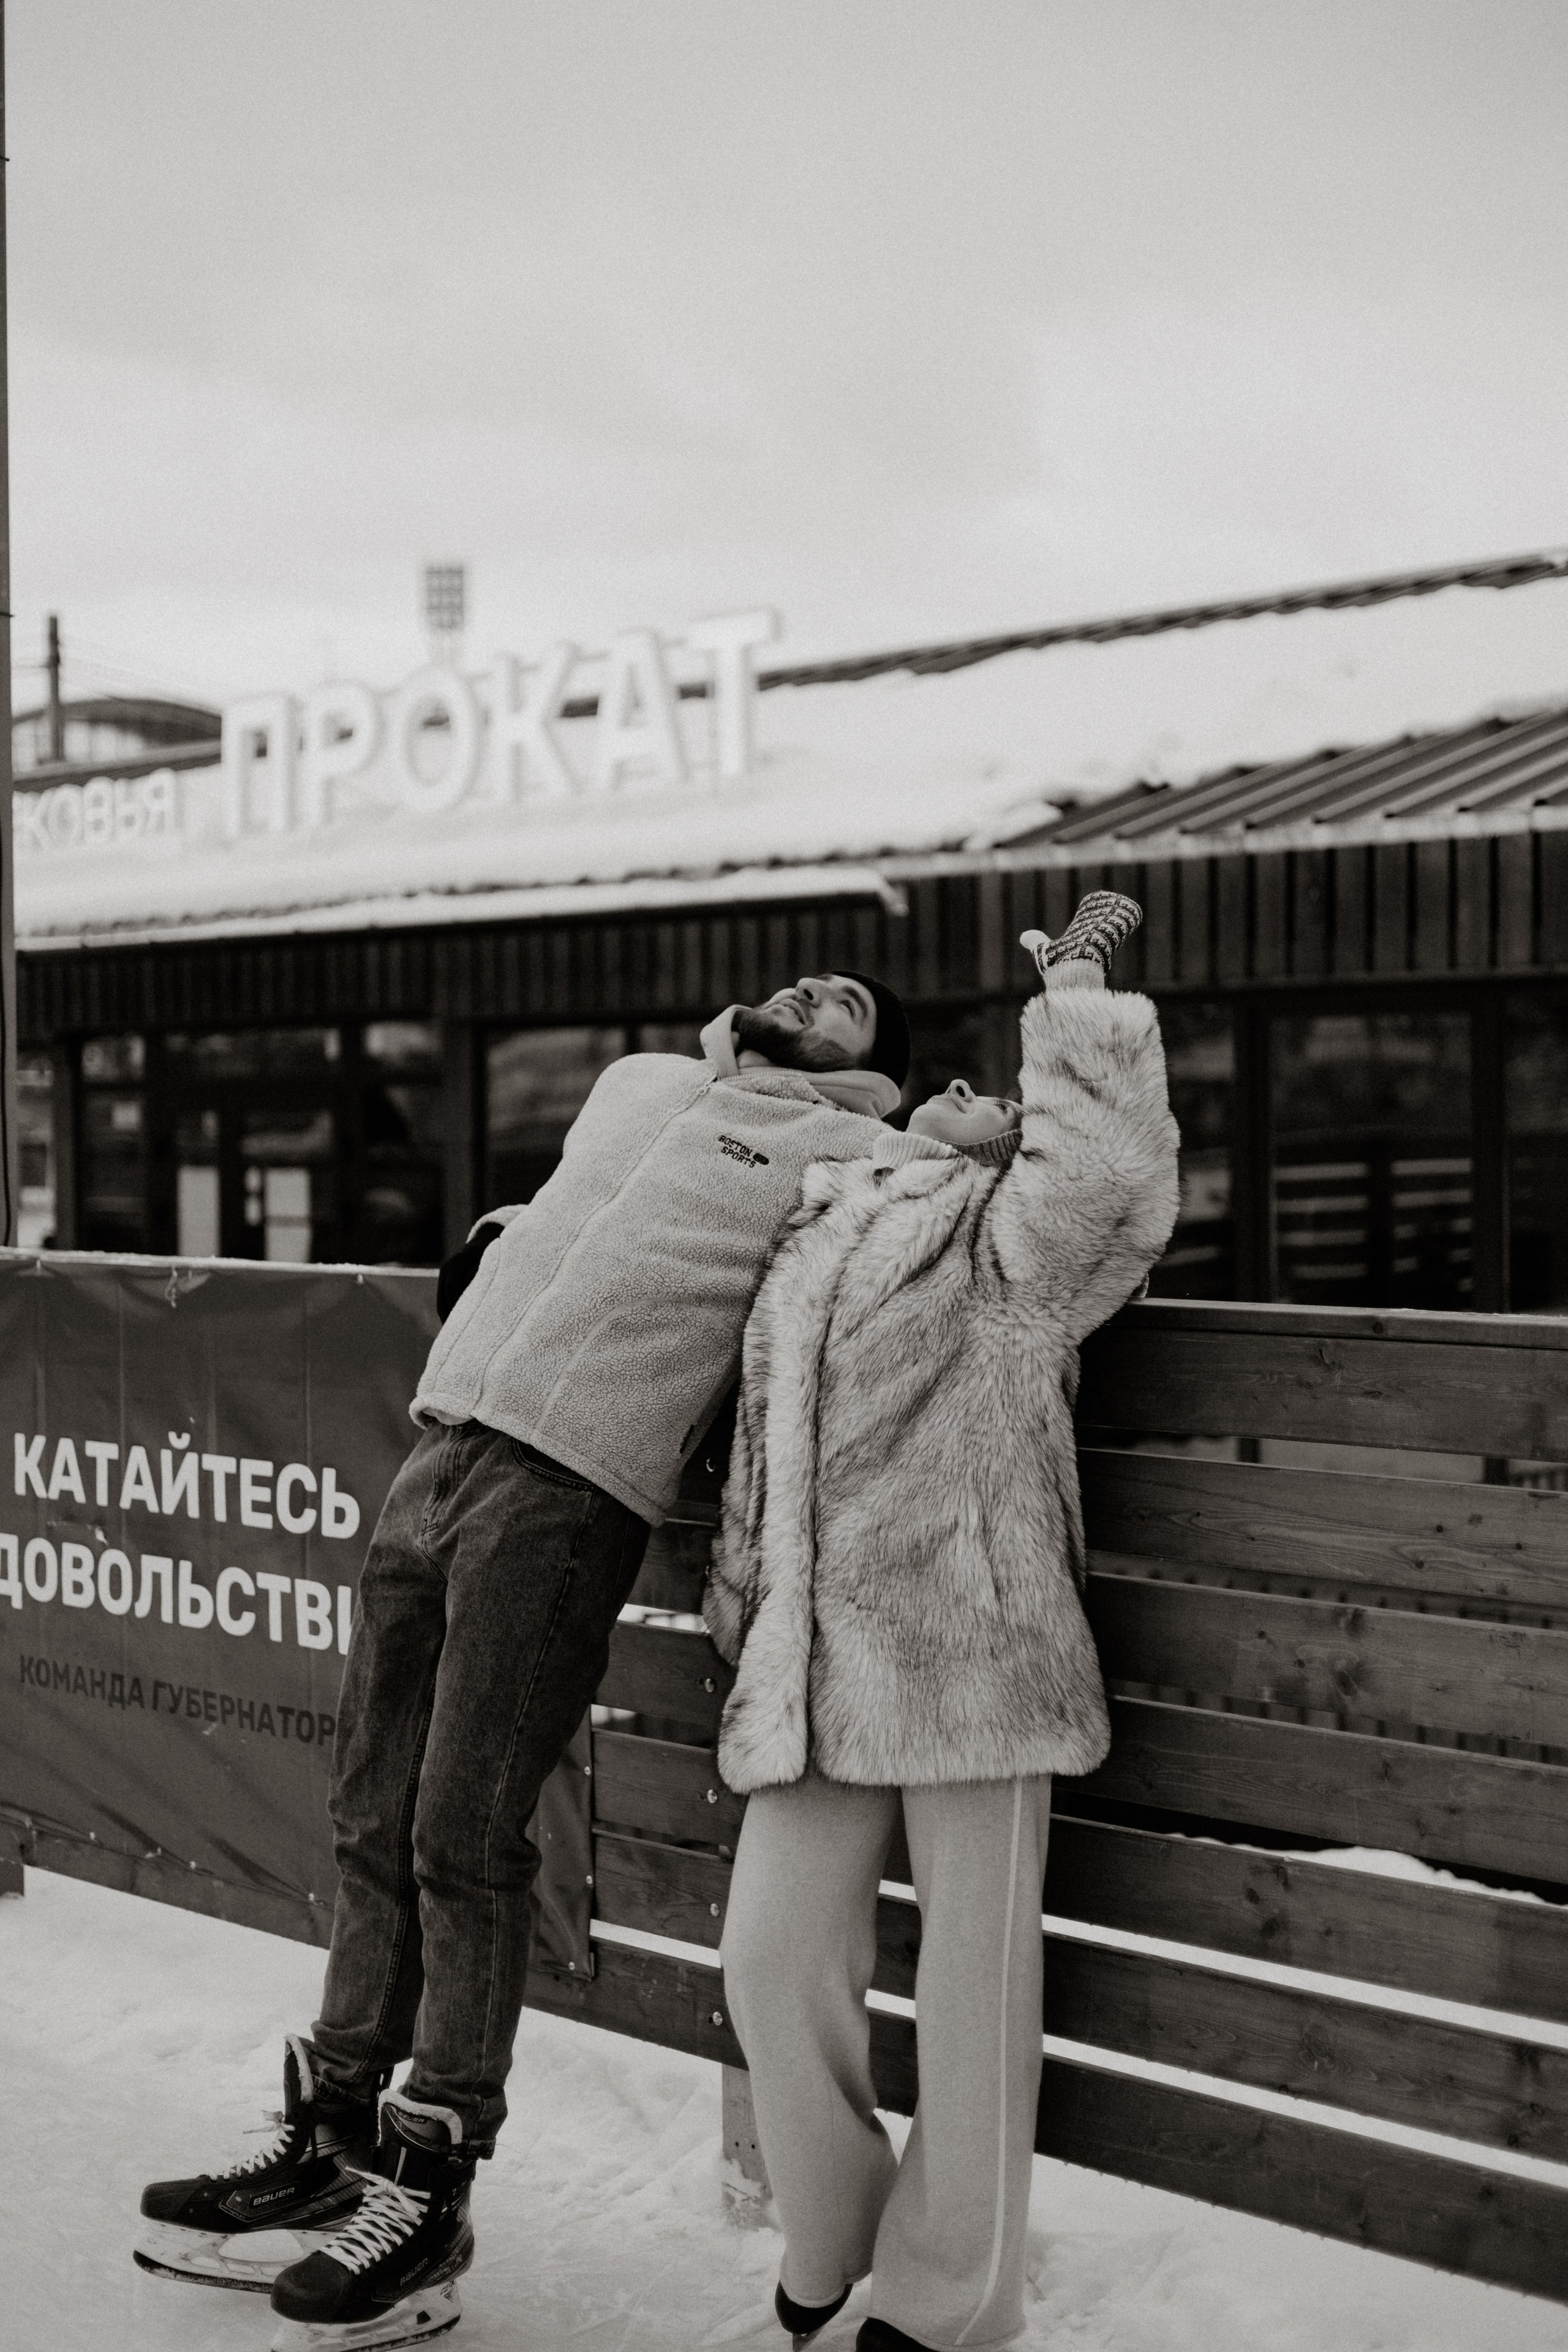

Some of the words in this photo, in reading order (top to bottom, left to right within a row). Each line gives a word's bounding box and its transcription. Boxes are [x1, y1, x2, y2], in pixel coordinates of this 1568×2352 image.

[221, 608, 778, 837] ПРОКАТ
[13, 767, 174, 850] КОВЬЯ
[718, 1135, 753, 1157] BOSTON
[721, 1146, 756, 1168] SPORTS
[14, 1431, 360, 1539] КАТАЙТЕСЬ
[20, 1656, 145, 1710] КОМАНДА
[153, 1681, 336, 1746] ГУБЕРНАТОР
[253, 2187, 295, 2206] BAUER
[399, 2257, 429, 2286] BAUER
